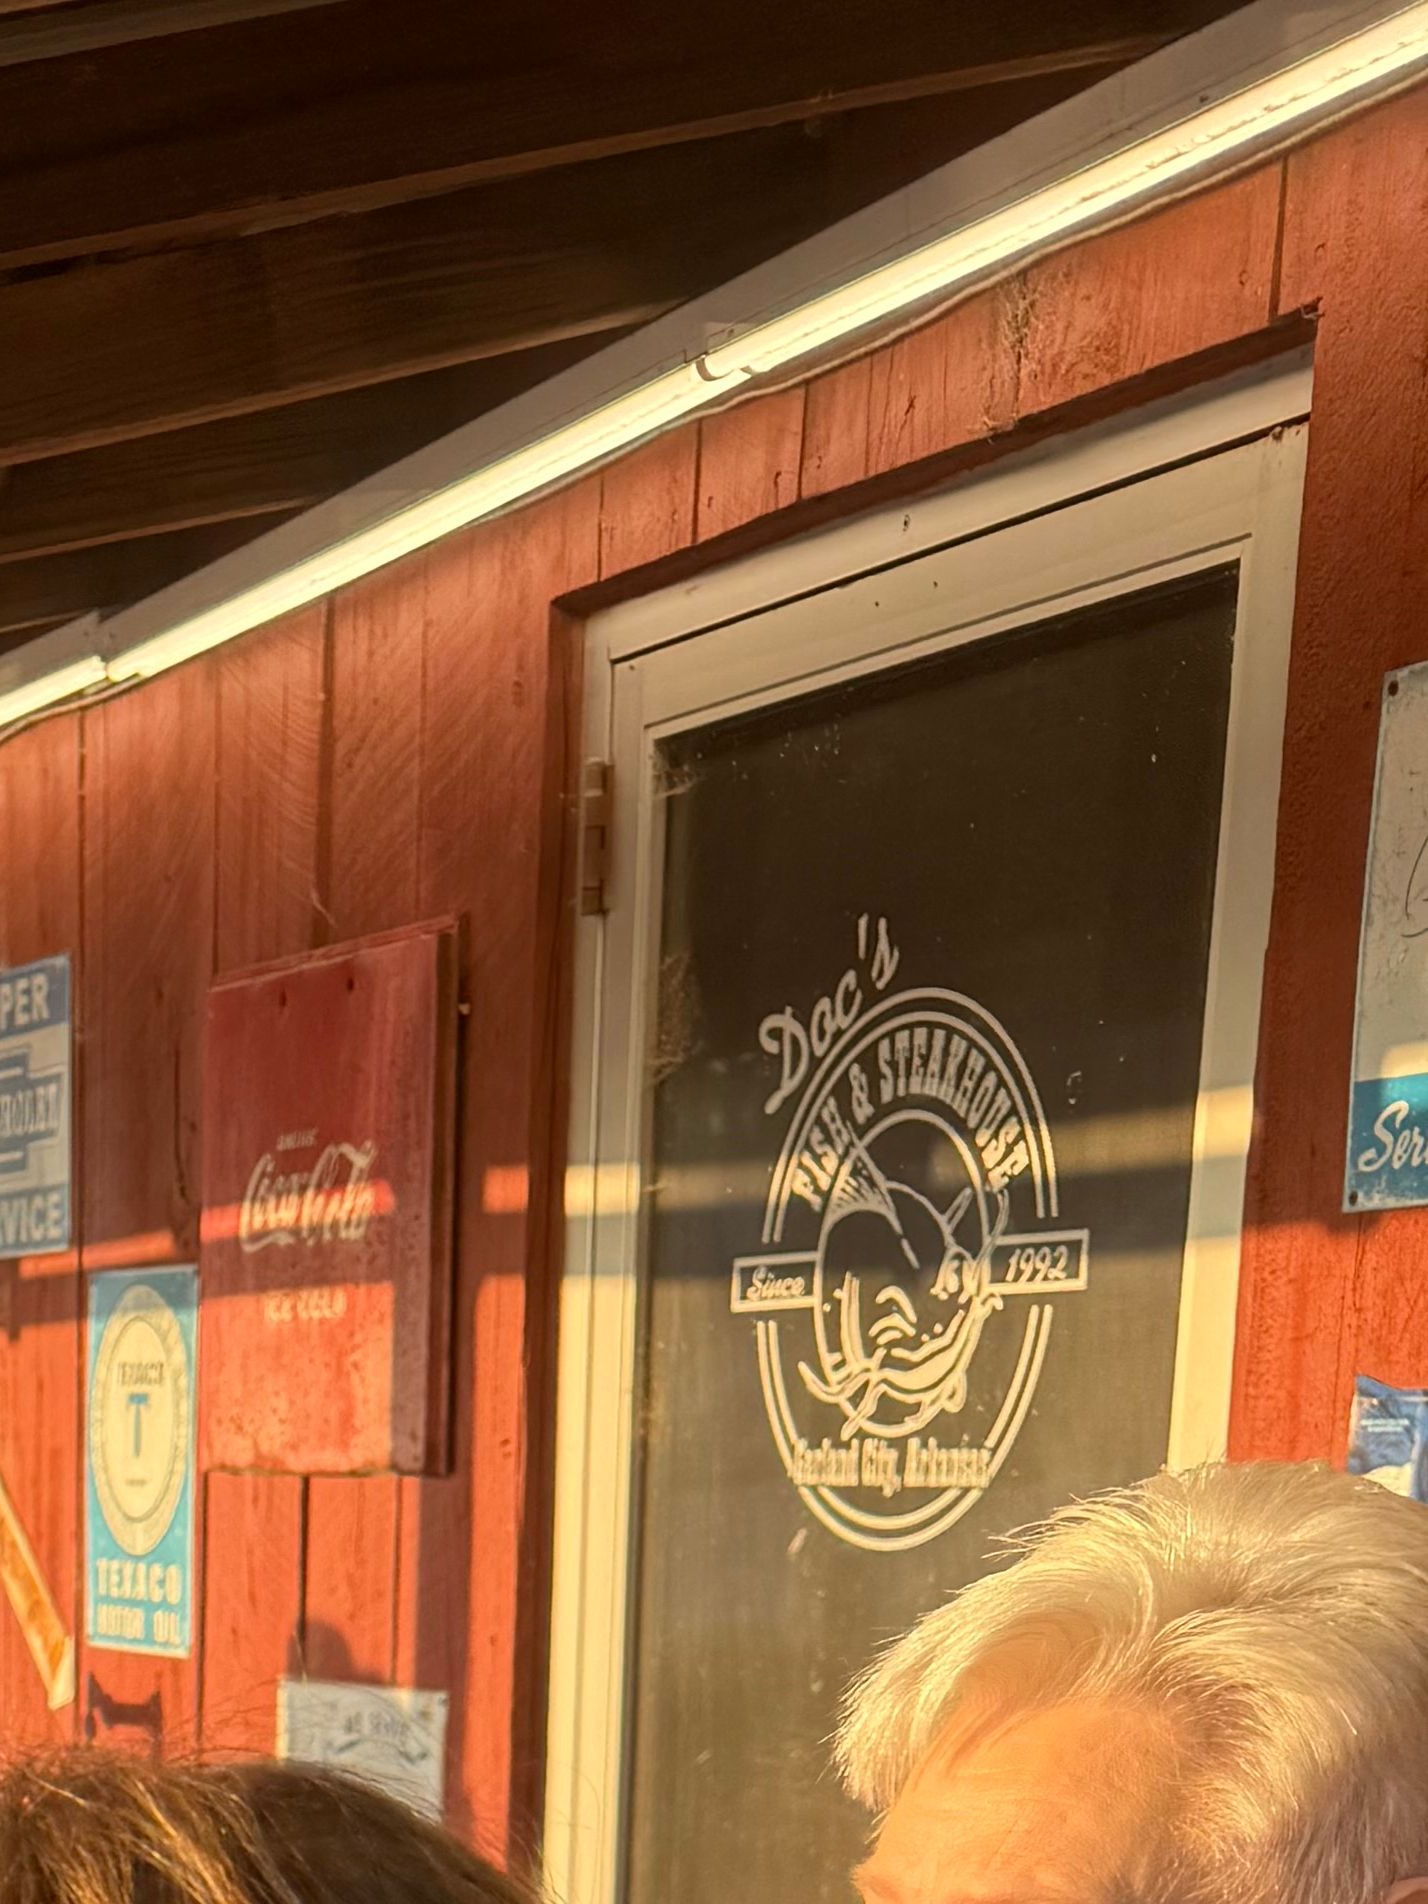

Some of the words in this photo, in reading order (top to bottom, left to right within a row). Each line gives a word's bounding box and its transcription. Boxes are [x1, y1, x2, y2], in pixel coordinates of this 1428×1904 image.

[759, 913, 900, 1115] Doc's
[791, 1095, 852, 1213] FISH
[847, 1061, 875, 1126] &
[877, 1026, 1030, 1193] STEAKHOUSE
[1357, 1100, 1428, 1173] Ser
[746, 1265, 806, 1300] Since
[1005, 1245, 1070, 1283] 1992
[96, 1556, 182, 1607] TEXACO
[151, 1608, 181, 1648] OIL
